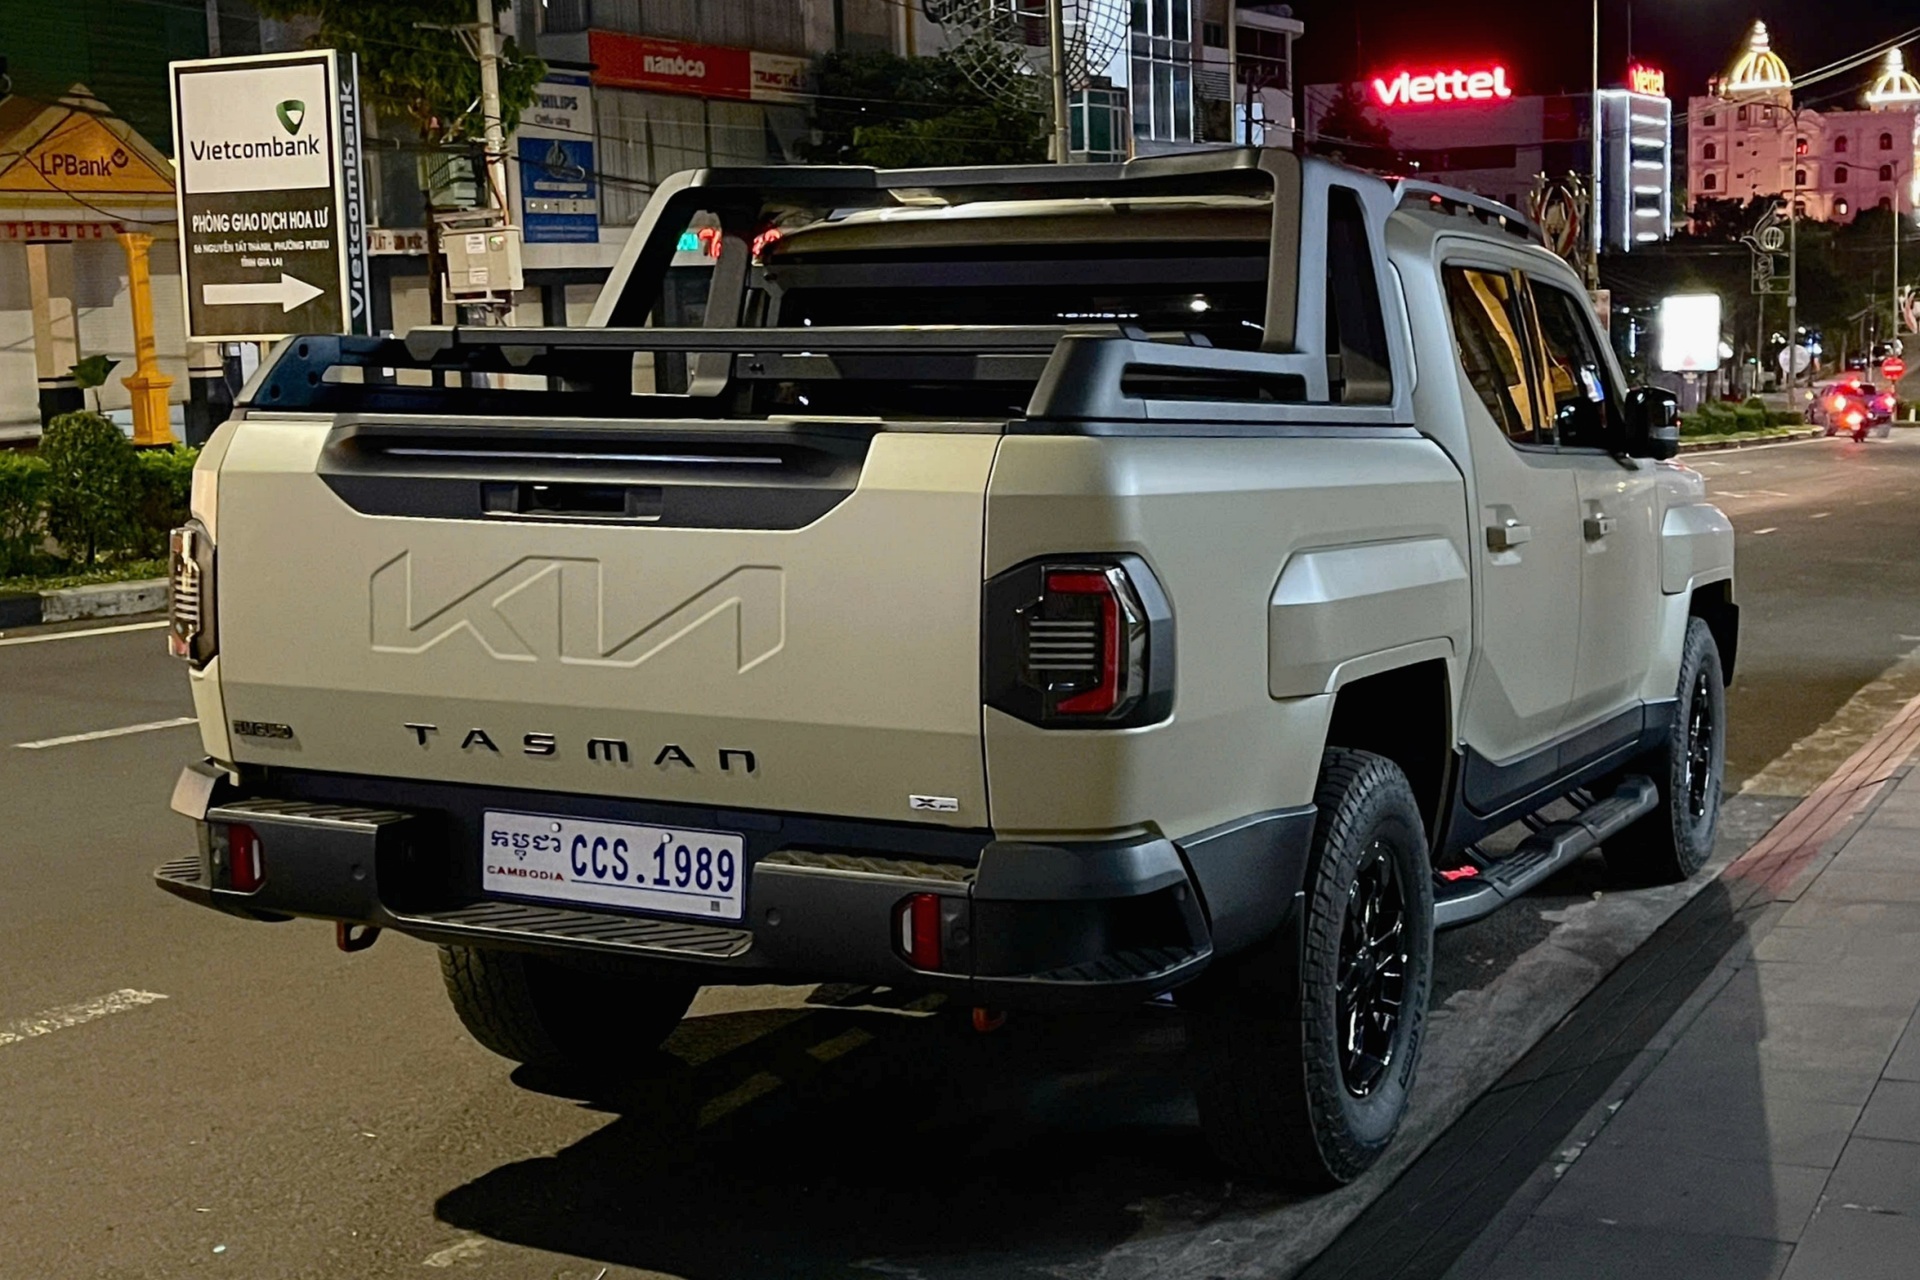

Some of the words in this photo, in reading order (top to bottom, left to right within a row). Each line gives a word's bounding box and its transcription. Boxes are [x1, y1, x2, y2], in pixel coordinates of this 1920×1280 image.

[537, 94, 578, 111] HILIPS
[190, 134, 320, 161] Vietcombank
[40, 152, 112, 177] LPBank
[341, 82, 363, 318] Vietcombank
[192, 210, 230, 233] PHÒNG
[232, 212, 259, 231] GIAO
[261, 211, 287, 234] DỊCH
[289, 210, 313, 229] HOA
[314, 206, 329, 228] LƯ
[403, 721, 756, 774] TASMAN
[486, 865, 565, 882] CAMBODIA
[570, 833, 736, 893] CCS.1989
